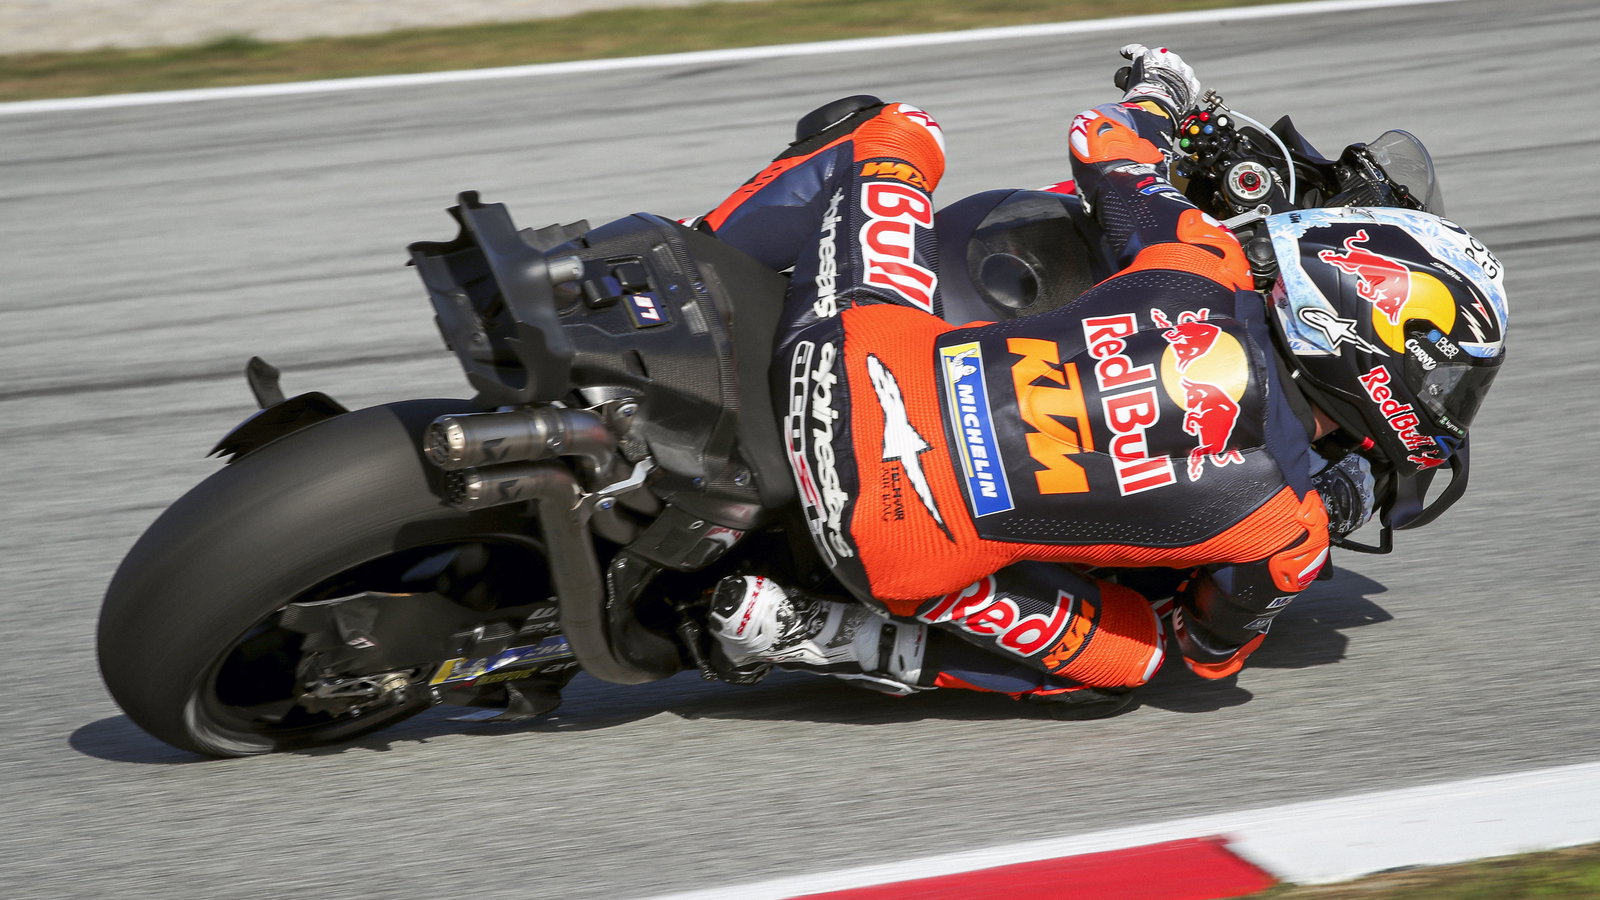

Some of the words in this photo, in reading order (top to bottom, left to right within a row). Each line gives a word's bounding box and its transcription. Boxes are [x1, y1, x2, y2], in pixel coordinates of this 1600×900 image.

[860, 162, 932, 192] KTM
[859, 182, 938, 315] Bull
[1081, 313, 1157, 391] Red
[811, 342, 854, 558] alpinestars
[957, 384, 998, 498] MICHELIN
[1006, 338, 1095, 495] KTM
[1101, 386, 1178, 497] Bull
[1357, 364, 1412, 420] Red
[1390, 410, 1437, 452] Bull
[917, 574, 1075, 658] Red
[1041, 599, 1095, 670] KTM
